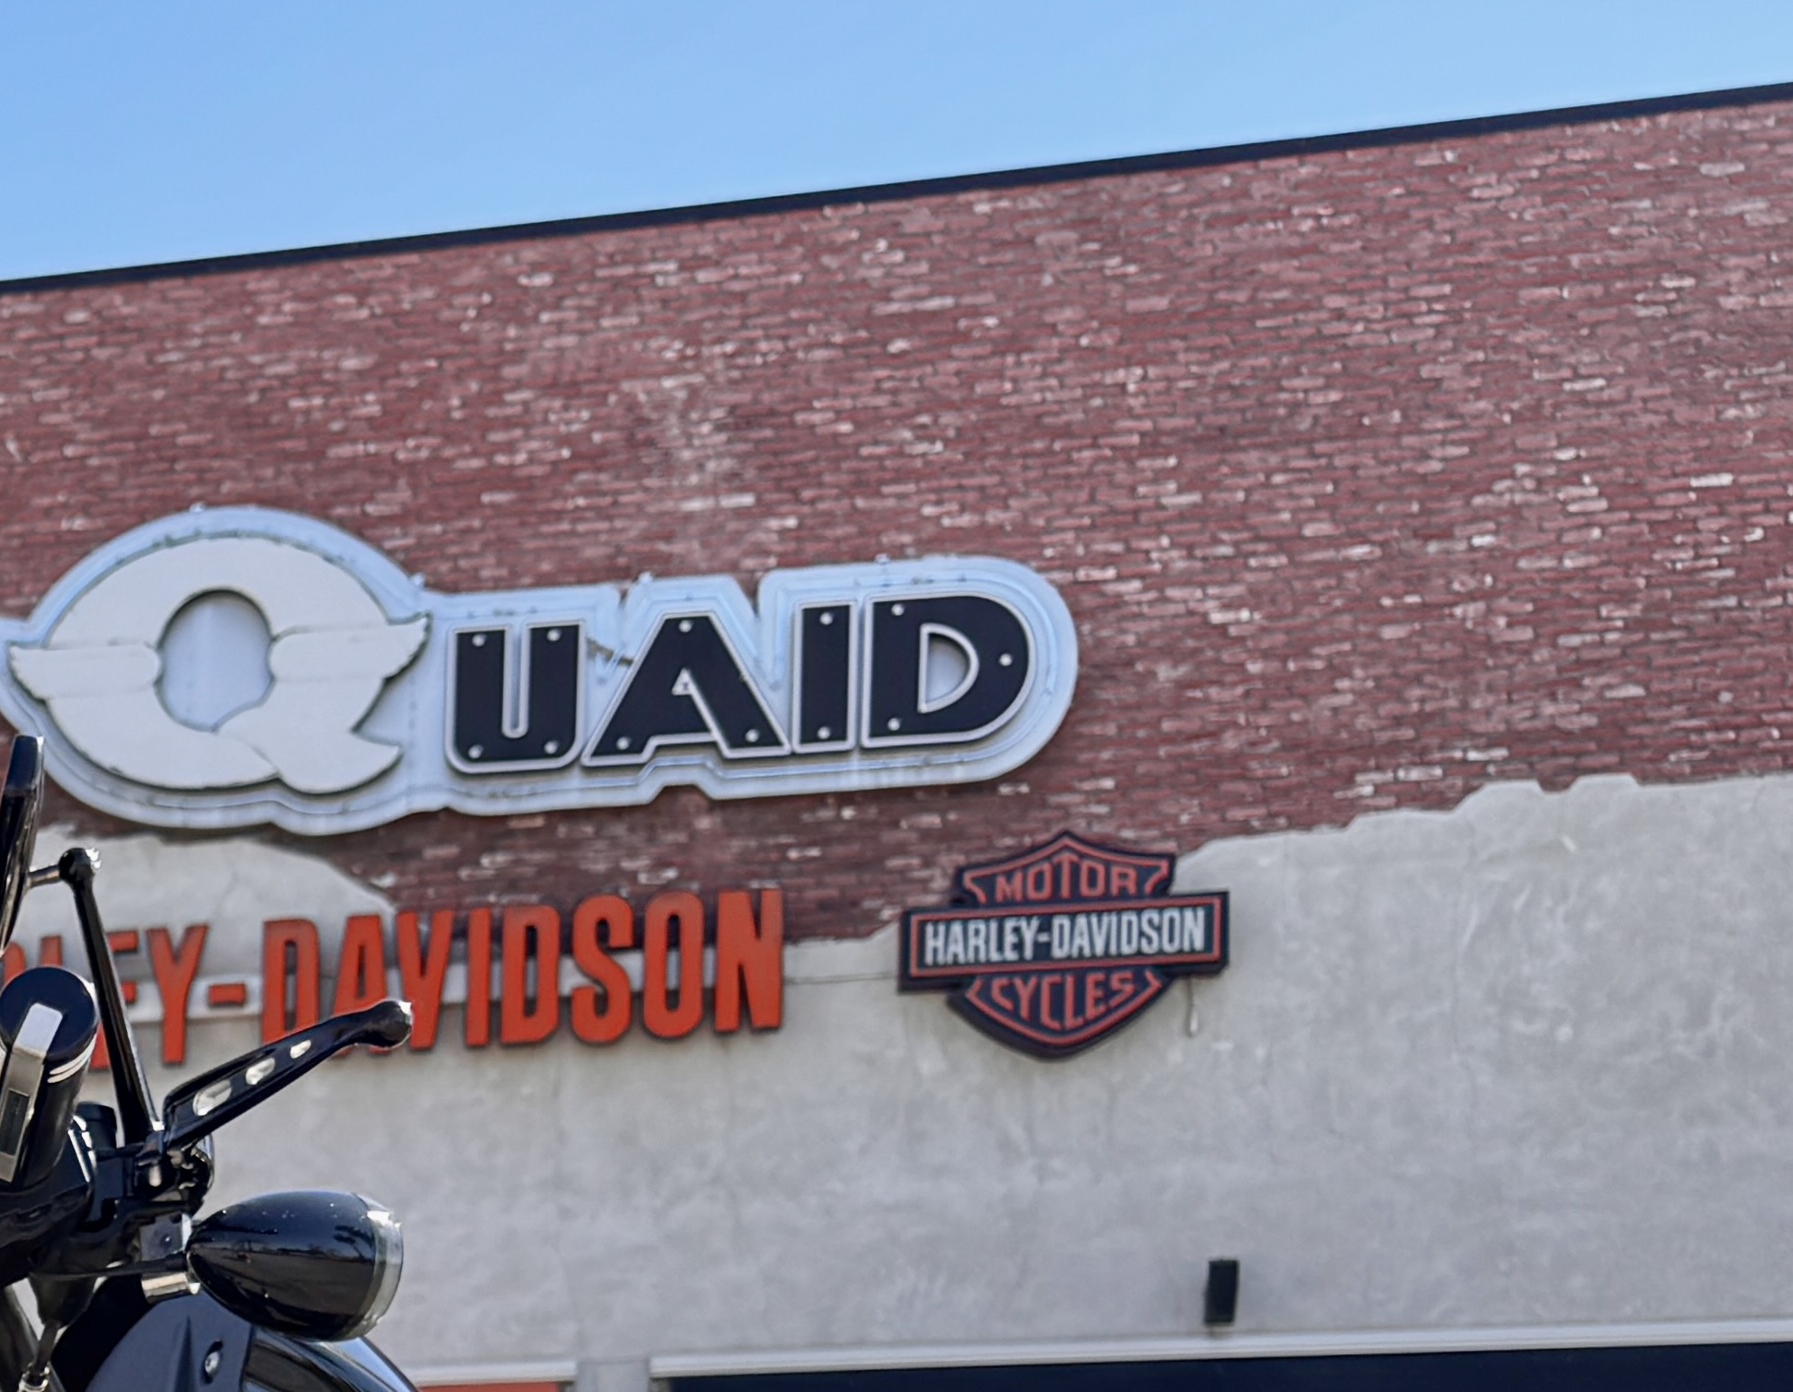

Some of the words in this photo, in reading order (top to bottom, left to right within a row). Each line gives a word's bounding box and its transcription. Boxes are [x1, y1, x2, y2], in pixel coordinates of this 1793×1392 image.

[9, 536, 1035, 796] QUAID
[995, 852, 1138, 903] MOTOR
[924, 906, 1206, 966] HARLEY-DAVIDSON
[991, 972, 1136, 1031] CYCLES
